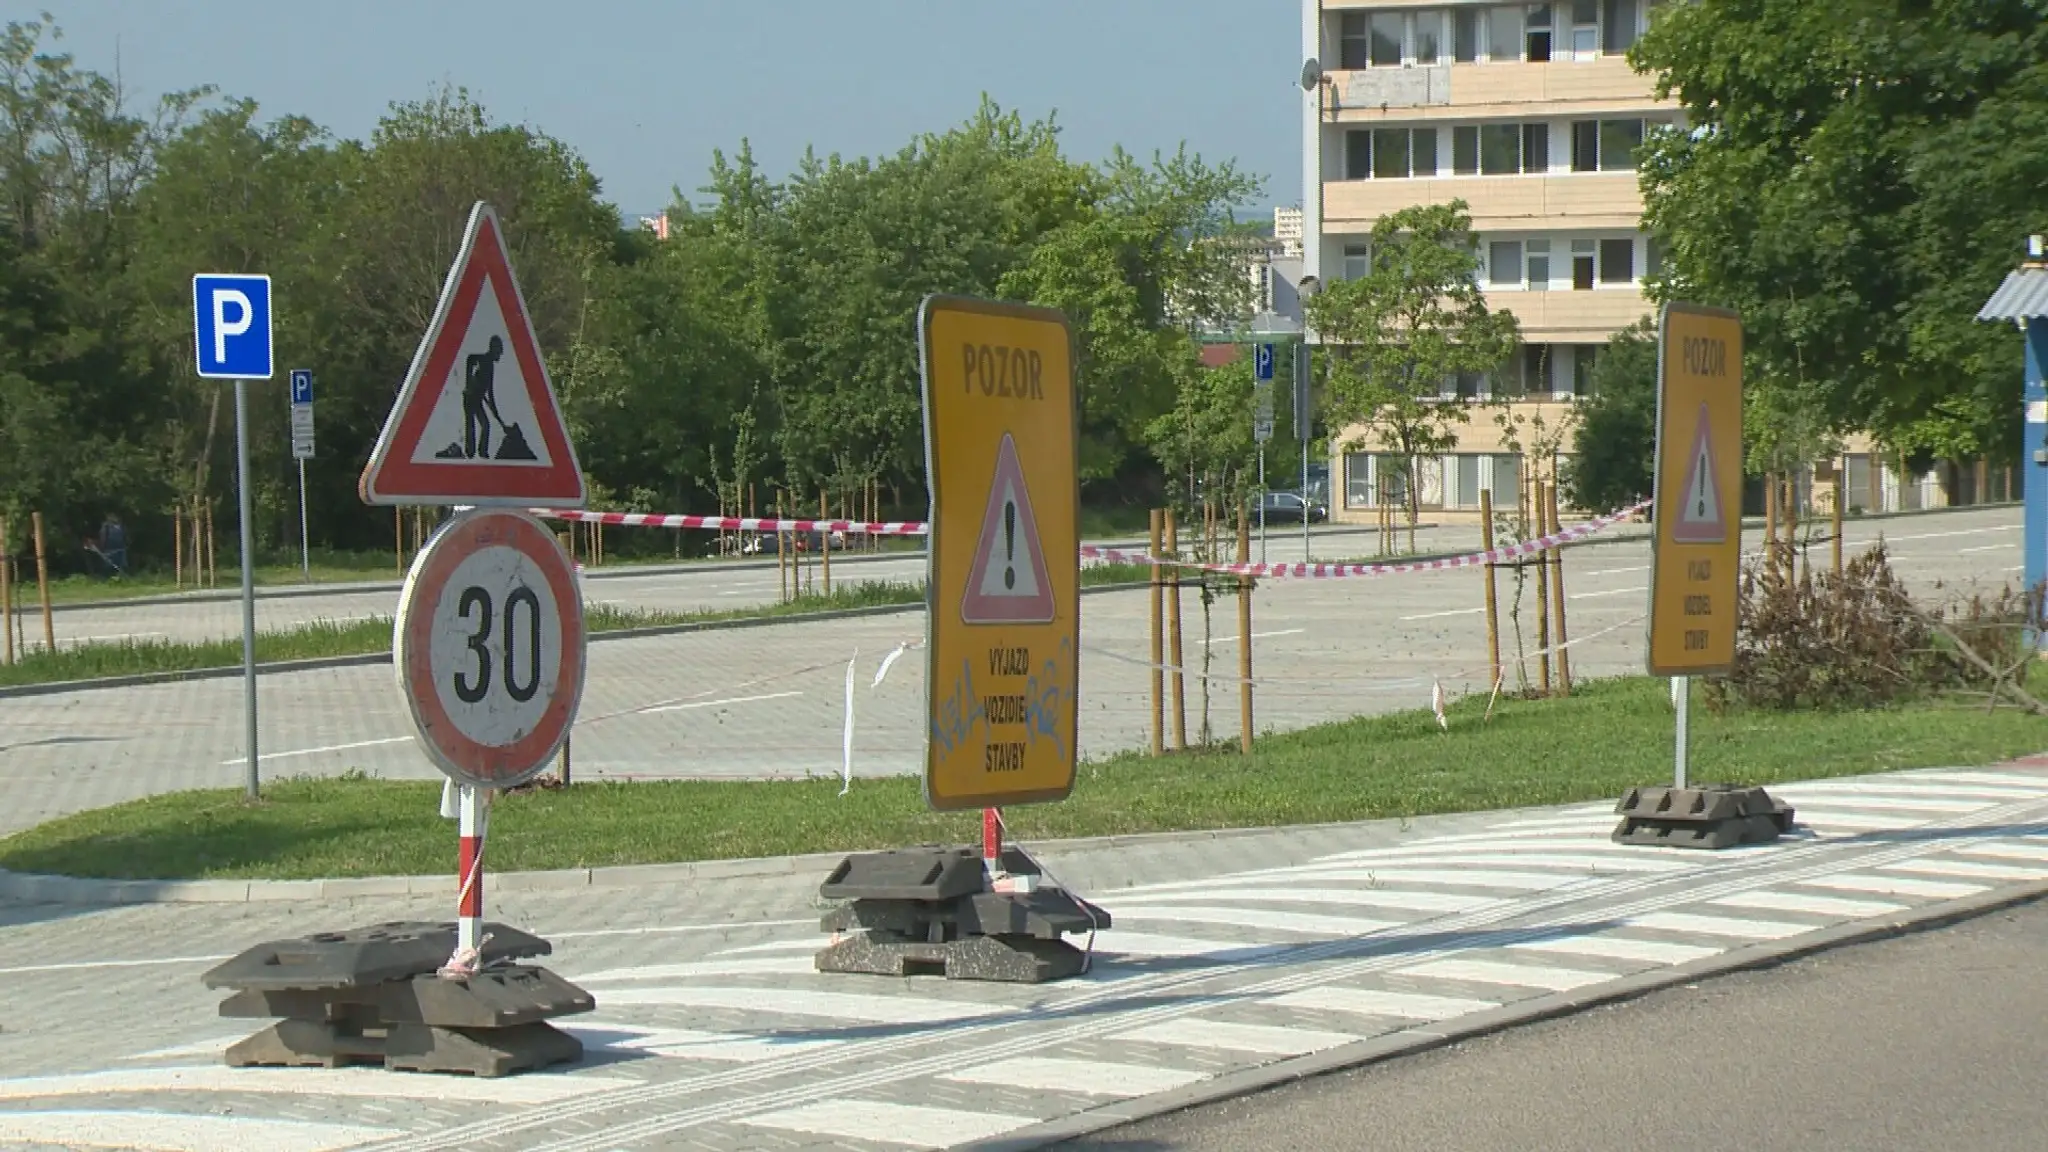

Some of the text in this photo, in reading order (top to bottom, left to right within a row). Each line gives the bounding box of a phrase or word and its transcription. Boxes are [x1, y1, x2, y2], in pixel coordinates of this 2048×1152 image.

[213, 289, 253, 364] P
[963, 342, 1044, 400] POZOR
[1683, 335, 1726, 377] POZOR
[296, 375, 308, 400] P
[454, 586, 541, 703] 30
[985, 742, 1027, 773] STAVBY
